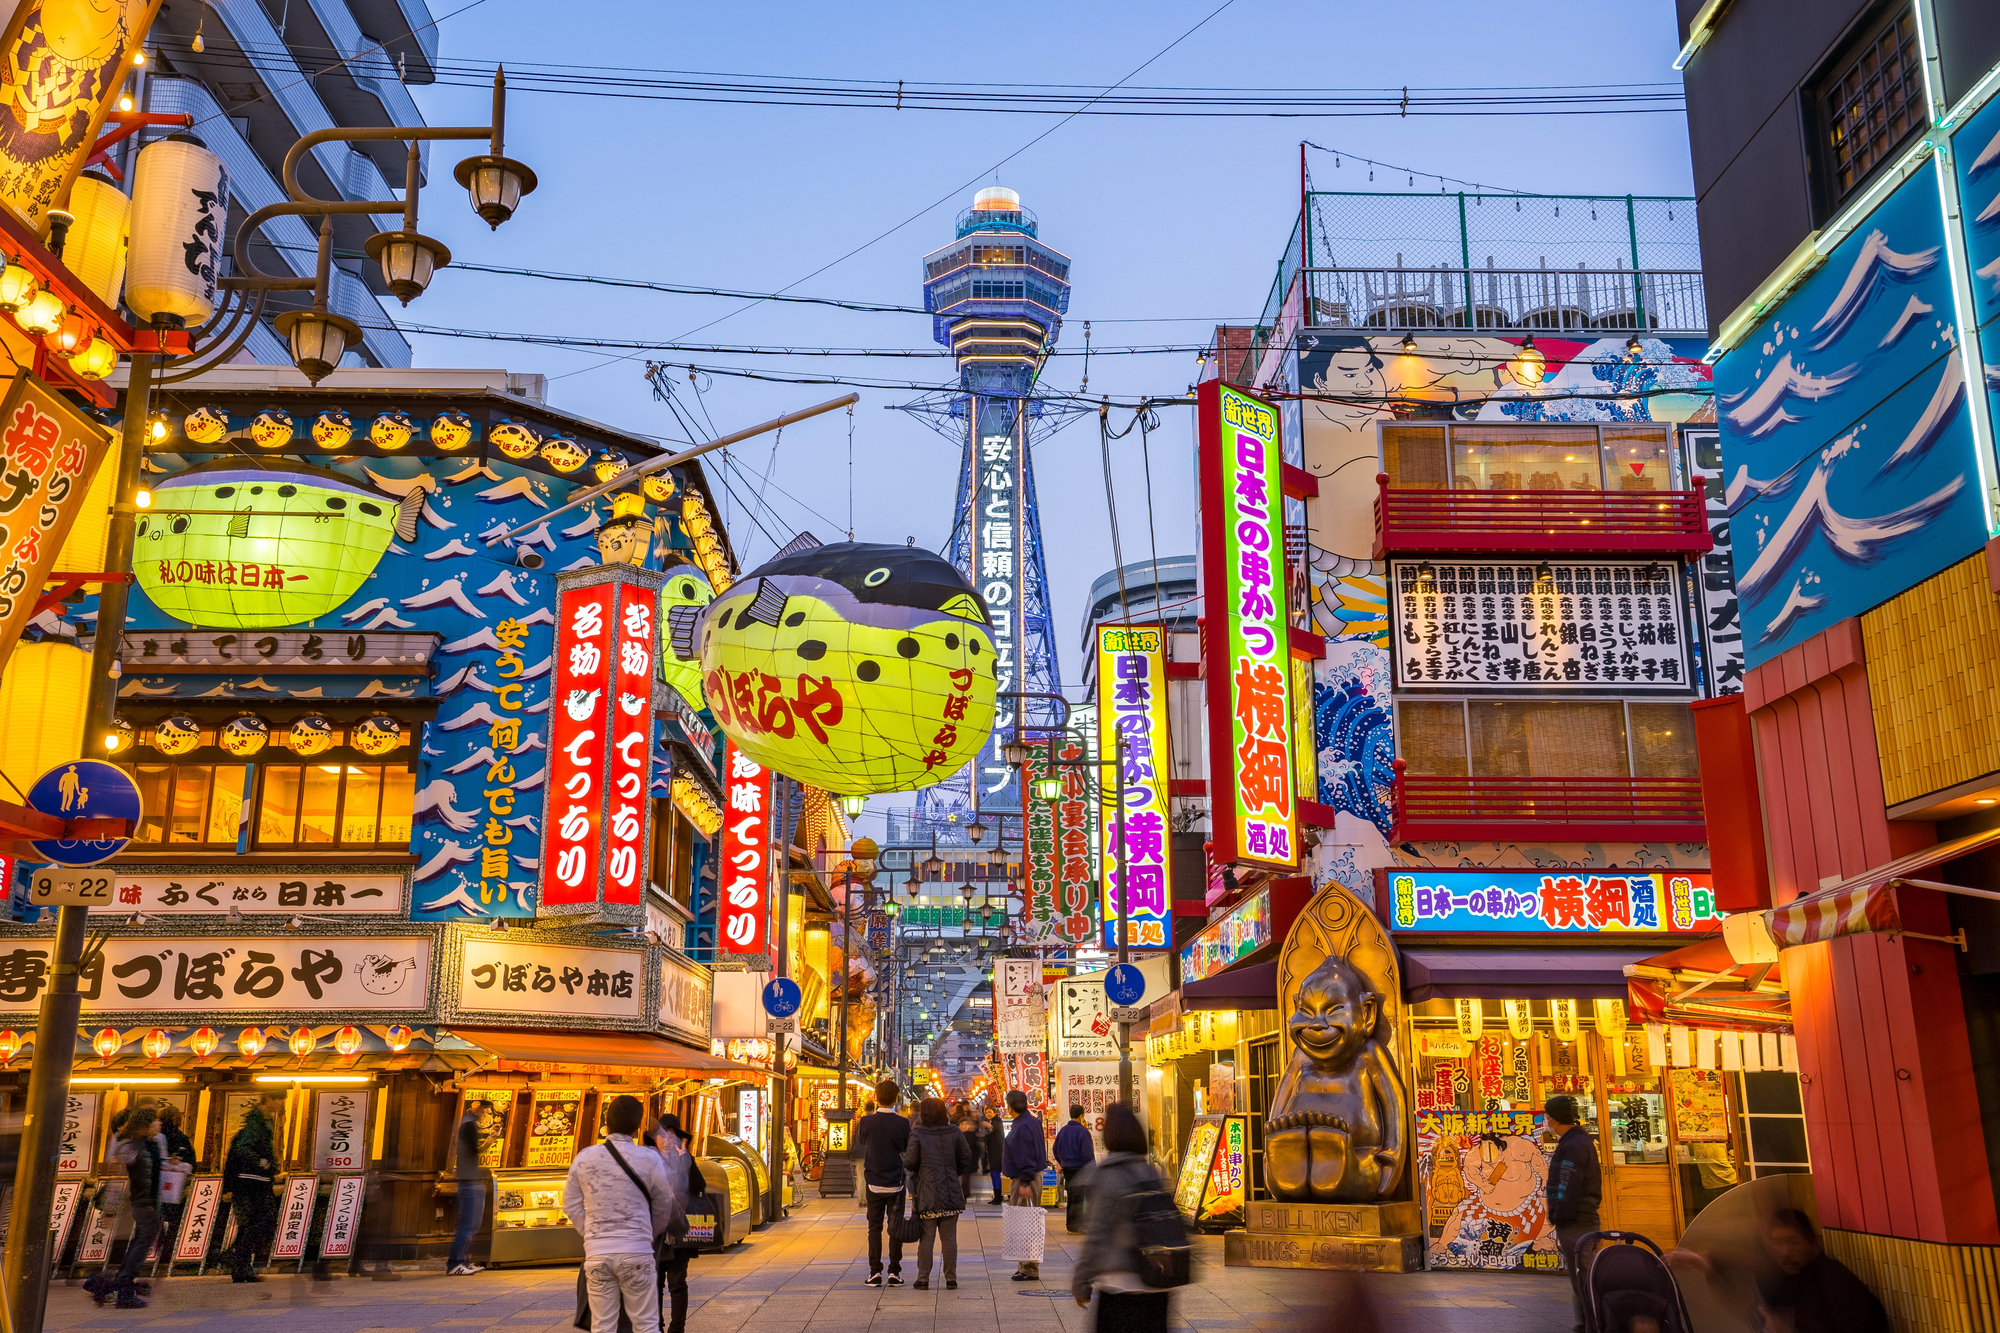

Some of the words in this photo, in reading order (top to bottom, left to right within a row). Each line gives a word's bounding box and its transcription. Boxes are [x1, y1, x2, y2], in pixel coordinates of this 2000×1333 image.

[1224, 394, 1275, 439] 新世界
[159, 559, 310, 590] 私の味は日本一
[1235, 432, 1278, 658] 日本一の串かつ
[569, 602, 604, 678] 名物
[620, 602, 651, 678] 名物
[1104, 631, 1160, 652] 新世界
[1404, 622, 1422, 681] もち
[1423, 622, 1444, 681] うずら玉子
[1443, 622, 1464, 681] 紅しょうが
[1462, 622, 1481, 681] にんにく
[1481, 622, 1502, 681] 玉ねぎ
[1501, 622, 1521, 681] 山芋
[1521, 622, 1542, 681] しし唐
[1540, 622, 1562, 681] れんこん
[1559, 622, 1581, 681] 銀杏
[1580, 622, 1601, 681] 白ねぎ
[1599, 622, 1620, 681] さつま芋
[1619, 622, 1640, 681] じゃが芋
[1638, 622, 1659, 681] 茄子
[1657, 622, 1679, 681] 椎茸
[707, 664, 844, 745] づぼらや
[922, 667, 974, 771] づぼらや
[1114, 655, 1154, 808] 日本一の串かつ
[480, 616, 530, 905] 安うて何んでも旨い
[1234, 659, 1289, 818] 横綱
[1108, 812, 1167, 916] 横綱
[1246, 820, 1290, 860] 酒処
[37, 878, 52, 897] 9
[79, 878, 109, 897] 22
[157, 881, 226, 907] ふぐ
[232, 885, 268, 902] なら
[278, 881, 384, 907] 日本一
[1396, 878, 1414, 926] 新世界
[1416, 888, 1536, 917] 日本一の串かつ
[1540, 877, 1630, 929] 横綱
[1631, 879, 1657, 928] 酒処
[1673, 880, 1691, 927] 新世界
[870, 912, 889, 949] 麻雀
[1116, 922, 1164, 946] 酒処
[112, 948, 343, 1001] づぼらや
[471, 961, 635, 1000] づぼらや本店
[1068, 1074, 1140, 1086] 元祖串カツ専店
[1630, 1035, 1645, 1072] にんにく
[329, 1095, 355, 1153] ふぐにぎり
[1420, 1112, 1536, 1136] 大阪新世界
[1622, 1097, 1652, 1143] 横綱
[1229, 1121, 1243, 1189] 本場の串かつ
[188, 1184, 213, 1243] ふぐ天丼
[285, 1182, 308, 1240] ふぐ小鍋定食
[1260, 1209, 1363, 1232] BILLIKEN
[1239, 1240, 1386, 1266] THINGS-AS-THEY
